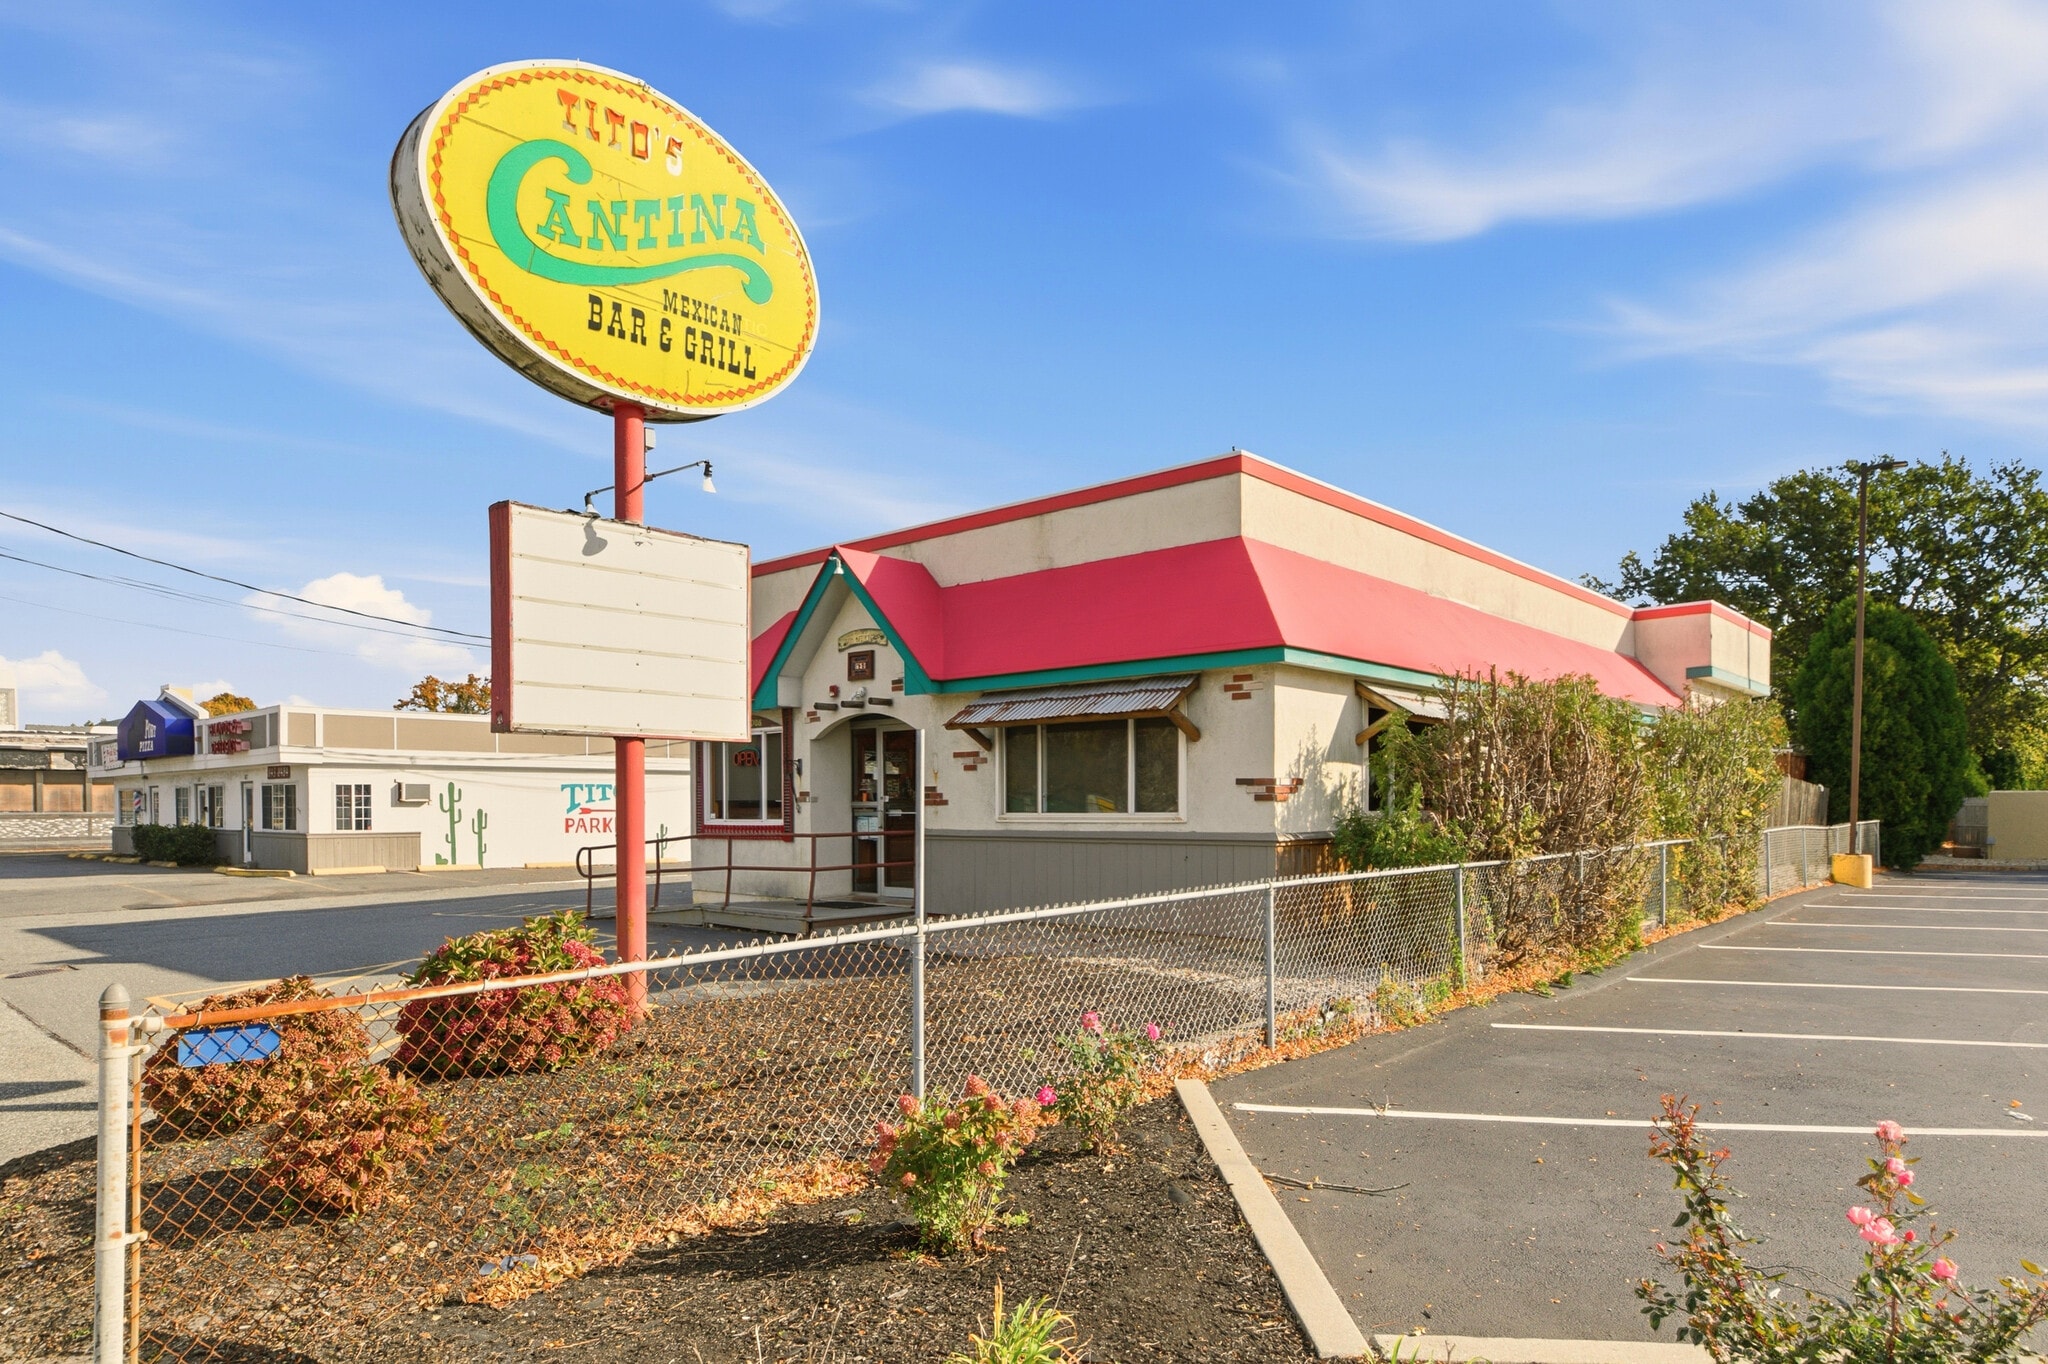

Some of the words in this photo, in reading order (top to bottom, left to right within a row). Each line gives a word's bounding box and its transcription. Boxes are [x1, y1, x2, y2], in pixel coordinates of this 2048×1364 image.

[557, 88, 683, 177] TITO'S
[486, 139, 774, 305] CANTINA
[588, 293, 647, 347] BAR
[659, 317, 673, 353] &
[684, 326, 757, 380] GRILL
[663, 289, 743, 337] MEXICAN
[733, 751, 759, 767] OPEN
[560, 783, 617, 815] TIT
[564, 817, 616, 834] PARK
